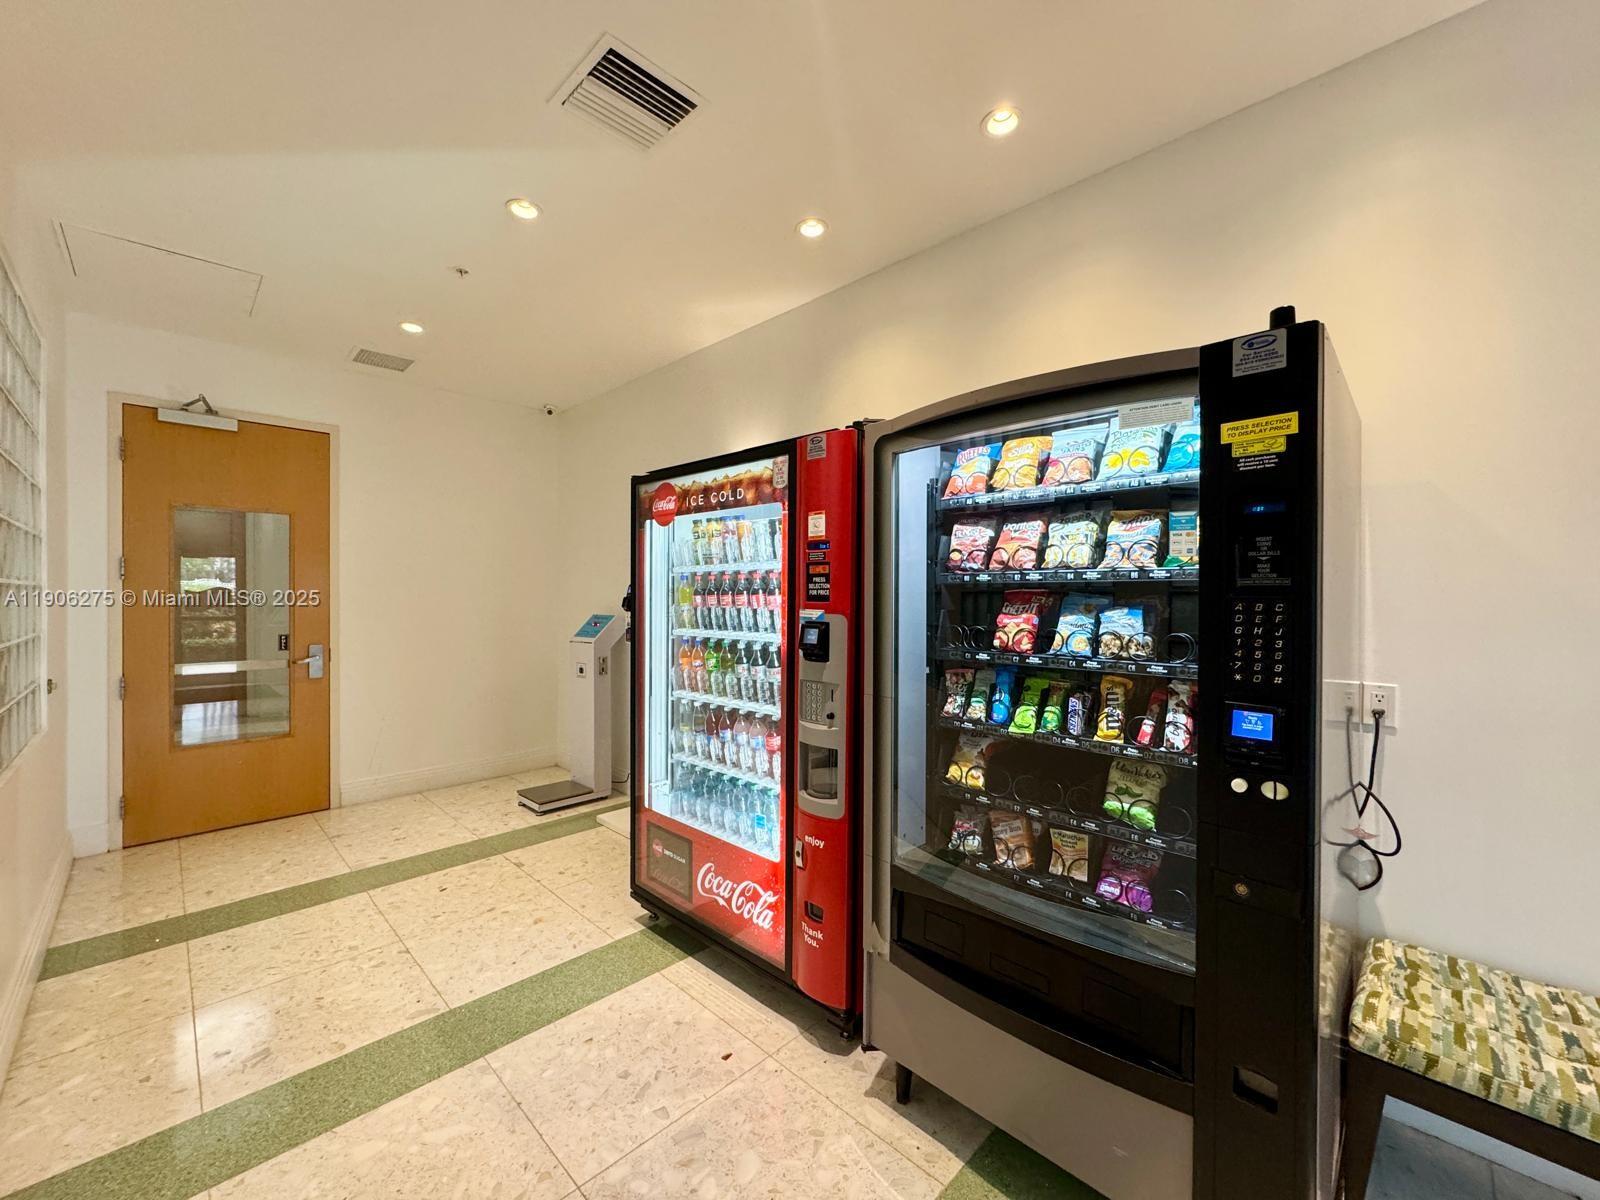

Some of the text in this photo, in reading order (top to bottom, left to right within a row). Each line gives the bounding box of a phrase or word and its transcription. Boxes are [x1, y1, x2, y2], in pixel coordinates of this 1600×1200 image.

[1226, 417, 1293, 432] PRESS SELECTION
[1237, 427, 1268, 436] DISPLAY
[1269, 424, 1292, 432] PRICE
[686, 488, 745, 507] ICE COLD
[1068, 699, 1078, 732] SNICKERS
[804, 834, 825, 849] enjoy
[697, 862, 780, 930] Coca-Cola
[801, 921, 824, 941] Thank
[803, 934, 819, 948] You.
